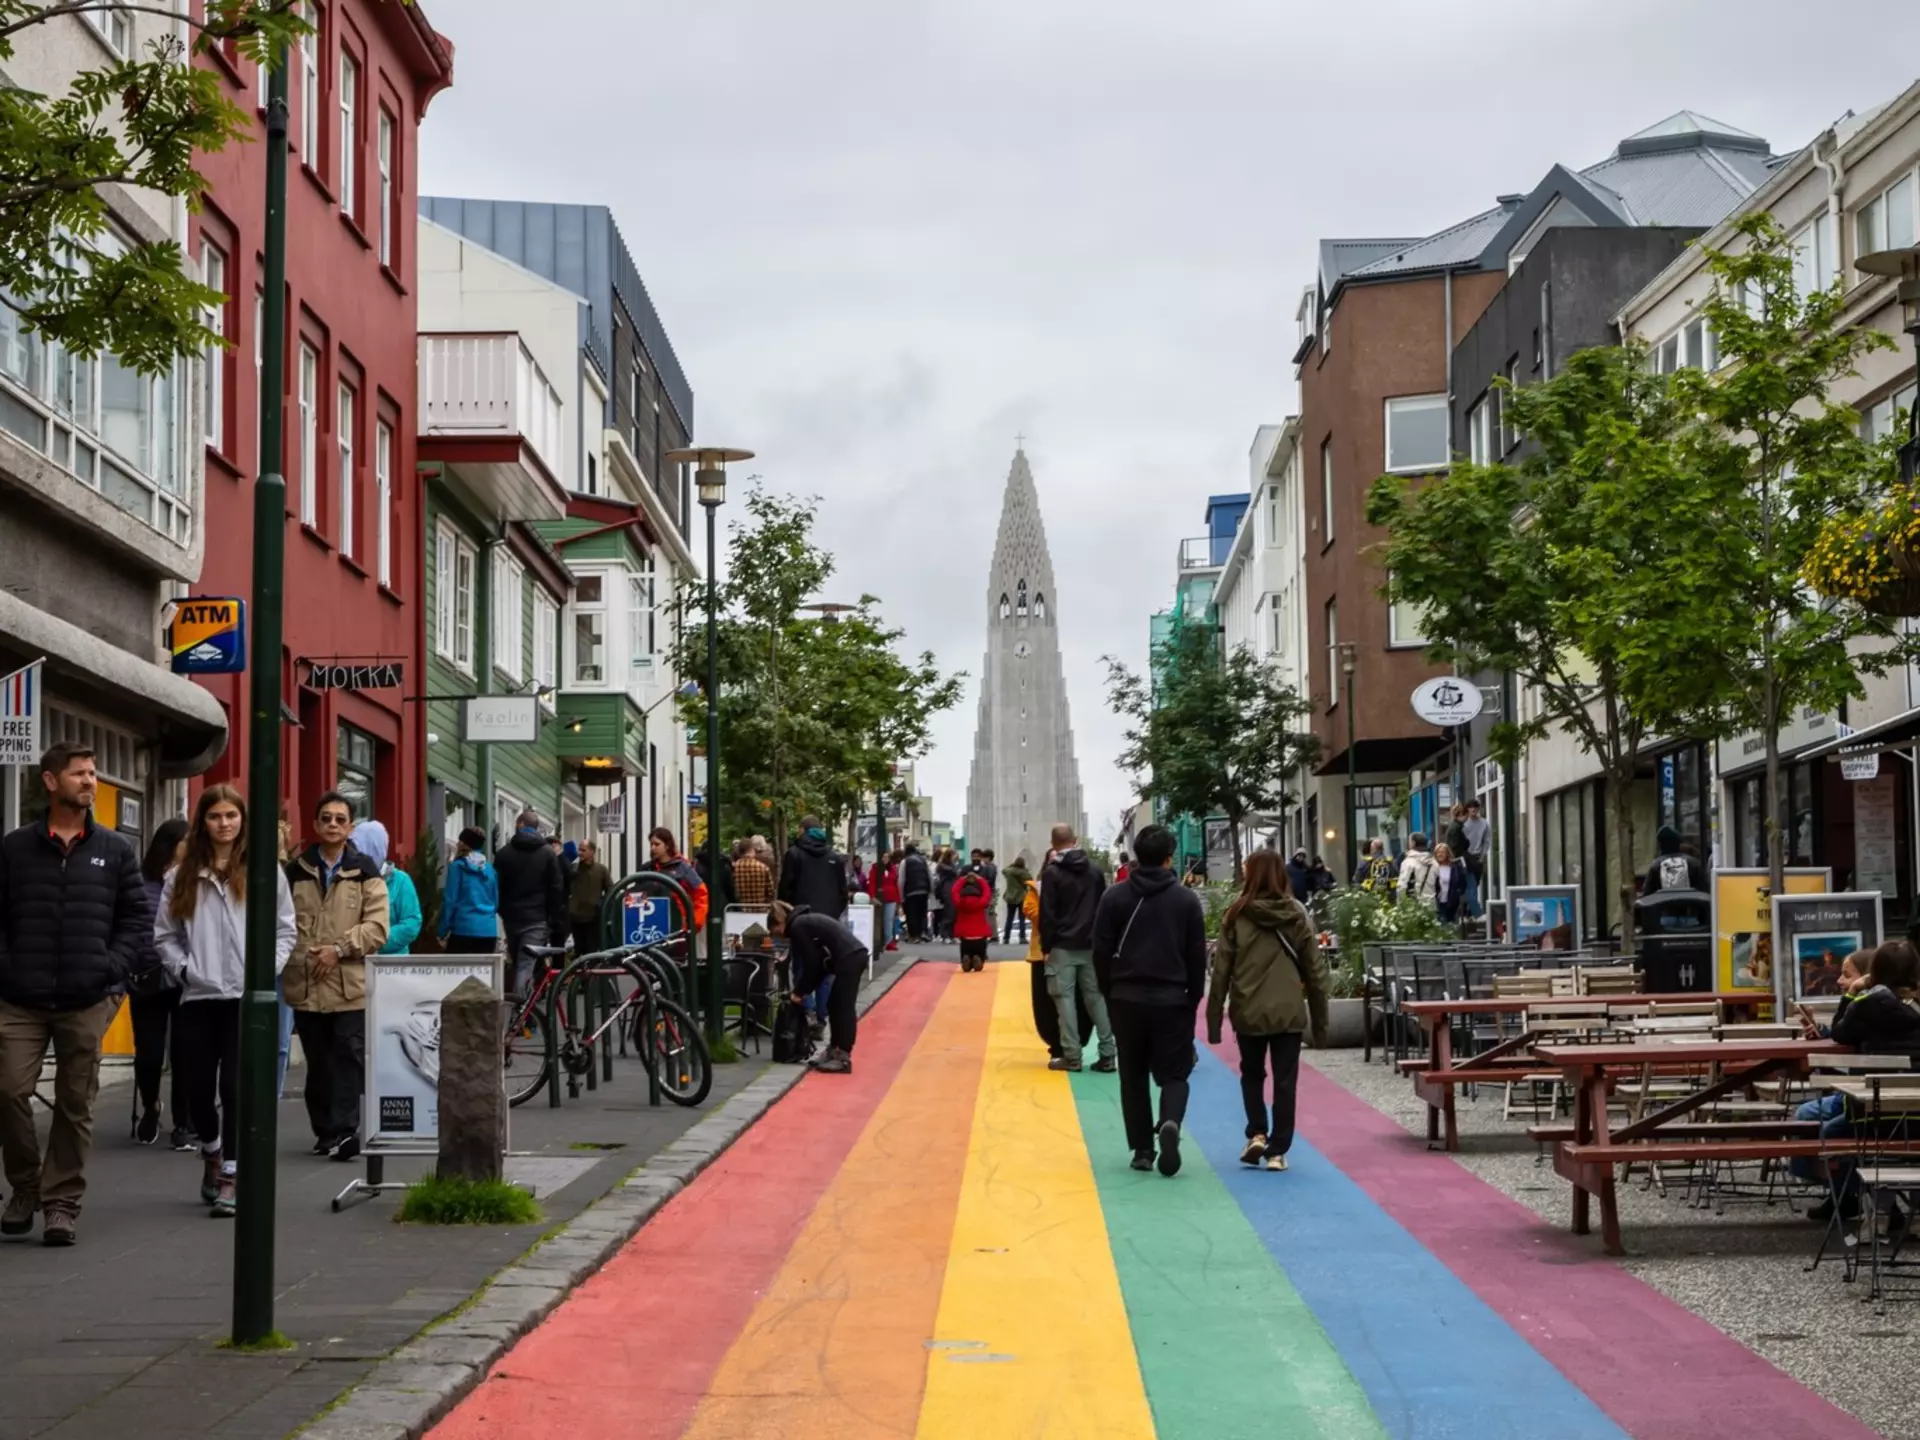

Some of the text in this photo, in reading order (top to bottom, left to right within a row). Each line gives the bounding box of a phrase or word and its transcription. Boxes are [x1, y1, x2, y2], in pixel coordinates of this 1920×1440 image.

[181, 606, 230, 624] ATM
[311, 664, 400, 692] MOKKA
[475, 708, 529, 725] Kaolin
[3, 721, 31, 737] FREE
[1823, 911, 1843, 919] fine
[1845, 910, 1859, 919] art
[377, 966, 490, 976] PURE AND TIMELESS
[383, 1099, 411, 1108] ANNA
[383, 1108, 411, 1117] MARIA
